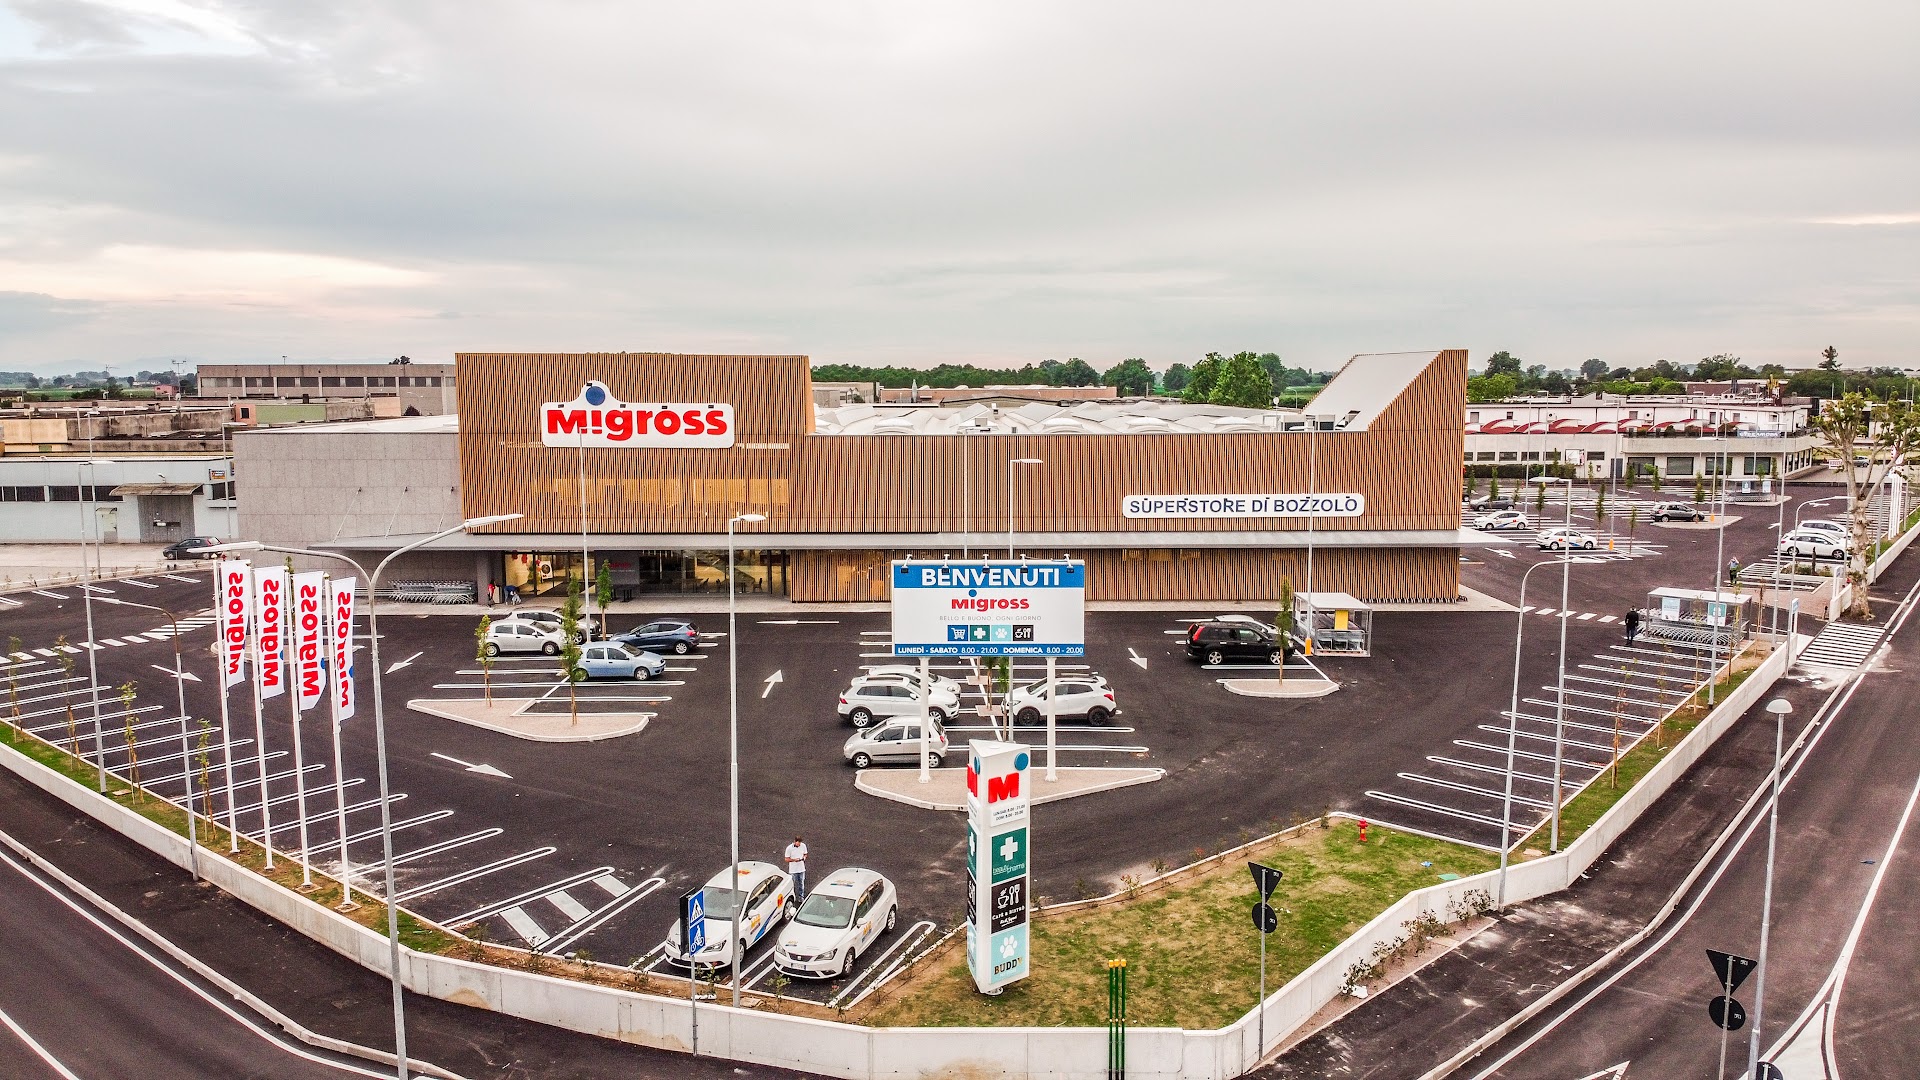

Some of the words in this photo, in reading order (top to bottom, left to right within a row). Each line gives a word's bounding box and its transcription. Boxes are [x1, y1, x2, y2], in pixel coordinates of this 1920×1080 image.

[547, 386, 728, 441] Migross
[1130, 500, 1245, 513] SUPERSTORE
[1252, 499, 1268, 512] DI
[1274, 498, 1357, 512] BOZZOLO
[922, 568, 1060, 586] BENVENUTI
[951, 589, 1030, 612] Migross
[898, 646, 924, 654] LUNEDÌ
[988, 772, 1019, 804] M
[994, 957, 1022, 975] BUDDY
